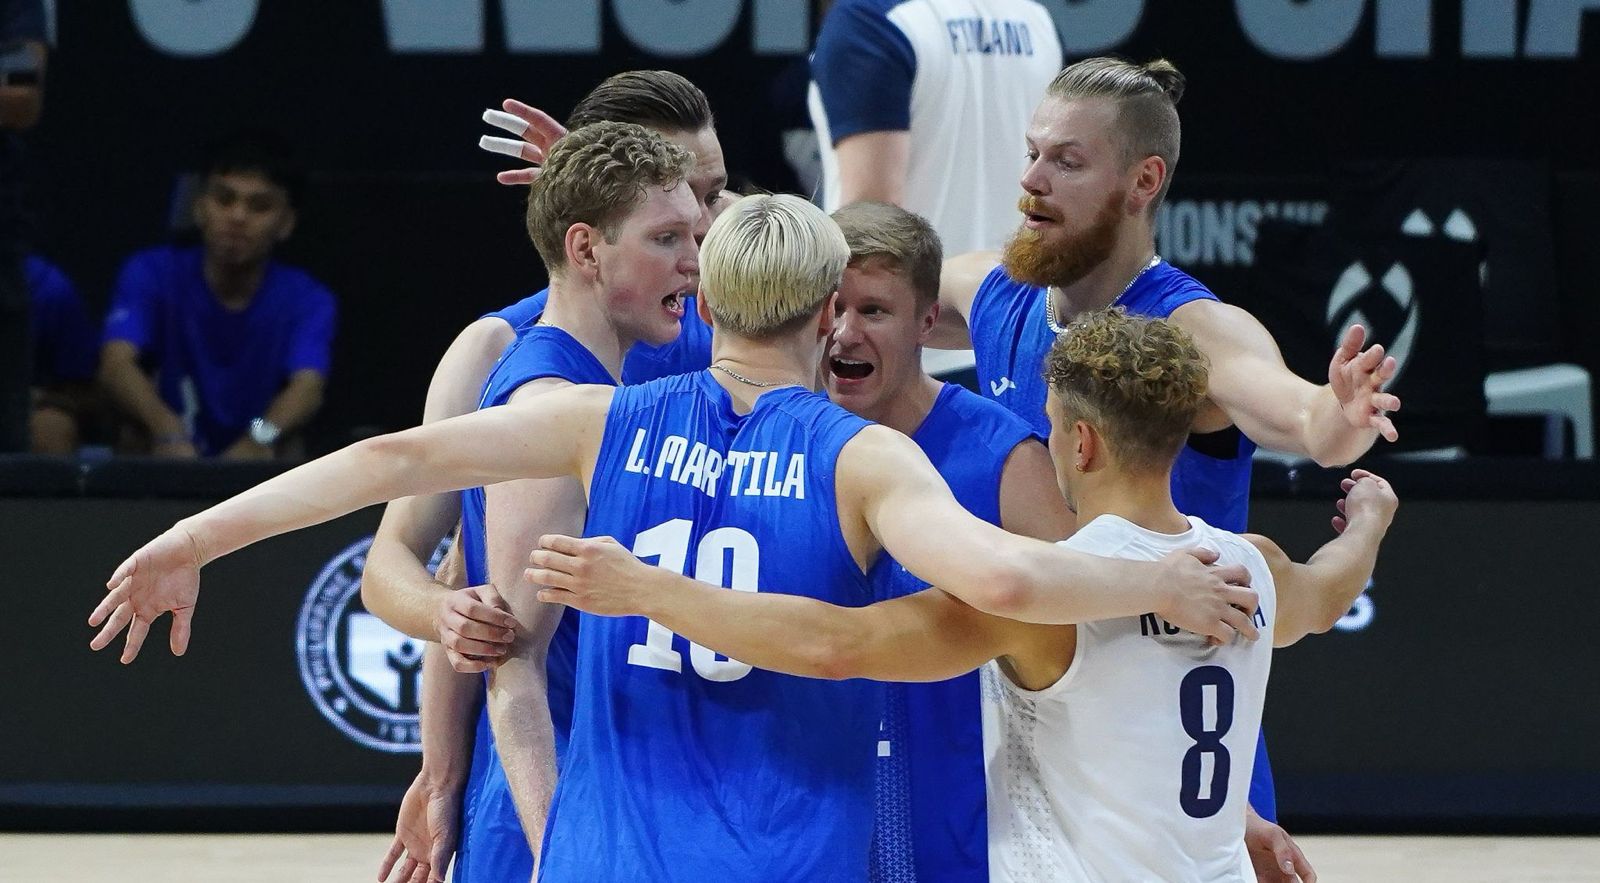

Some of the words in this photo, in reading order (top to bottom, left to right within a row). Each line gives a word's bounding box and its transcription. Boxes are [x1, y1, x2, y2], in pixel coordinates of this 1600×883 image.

[625, 428, 650, 474] L.
[654, 435, 805, 500] MARTILA
[627, 518, 760, 682] 10
[1179, 665, 1235, 819] 8
